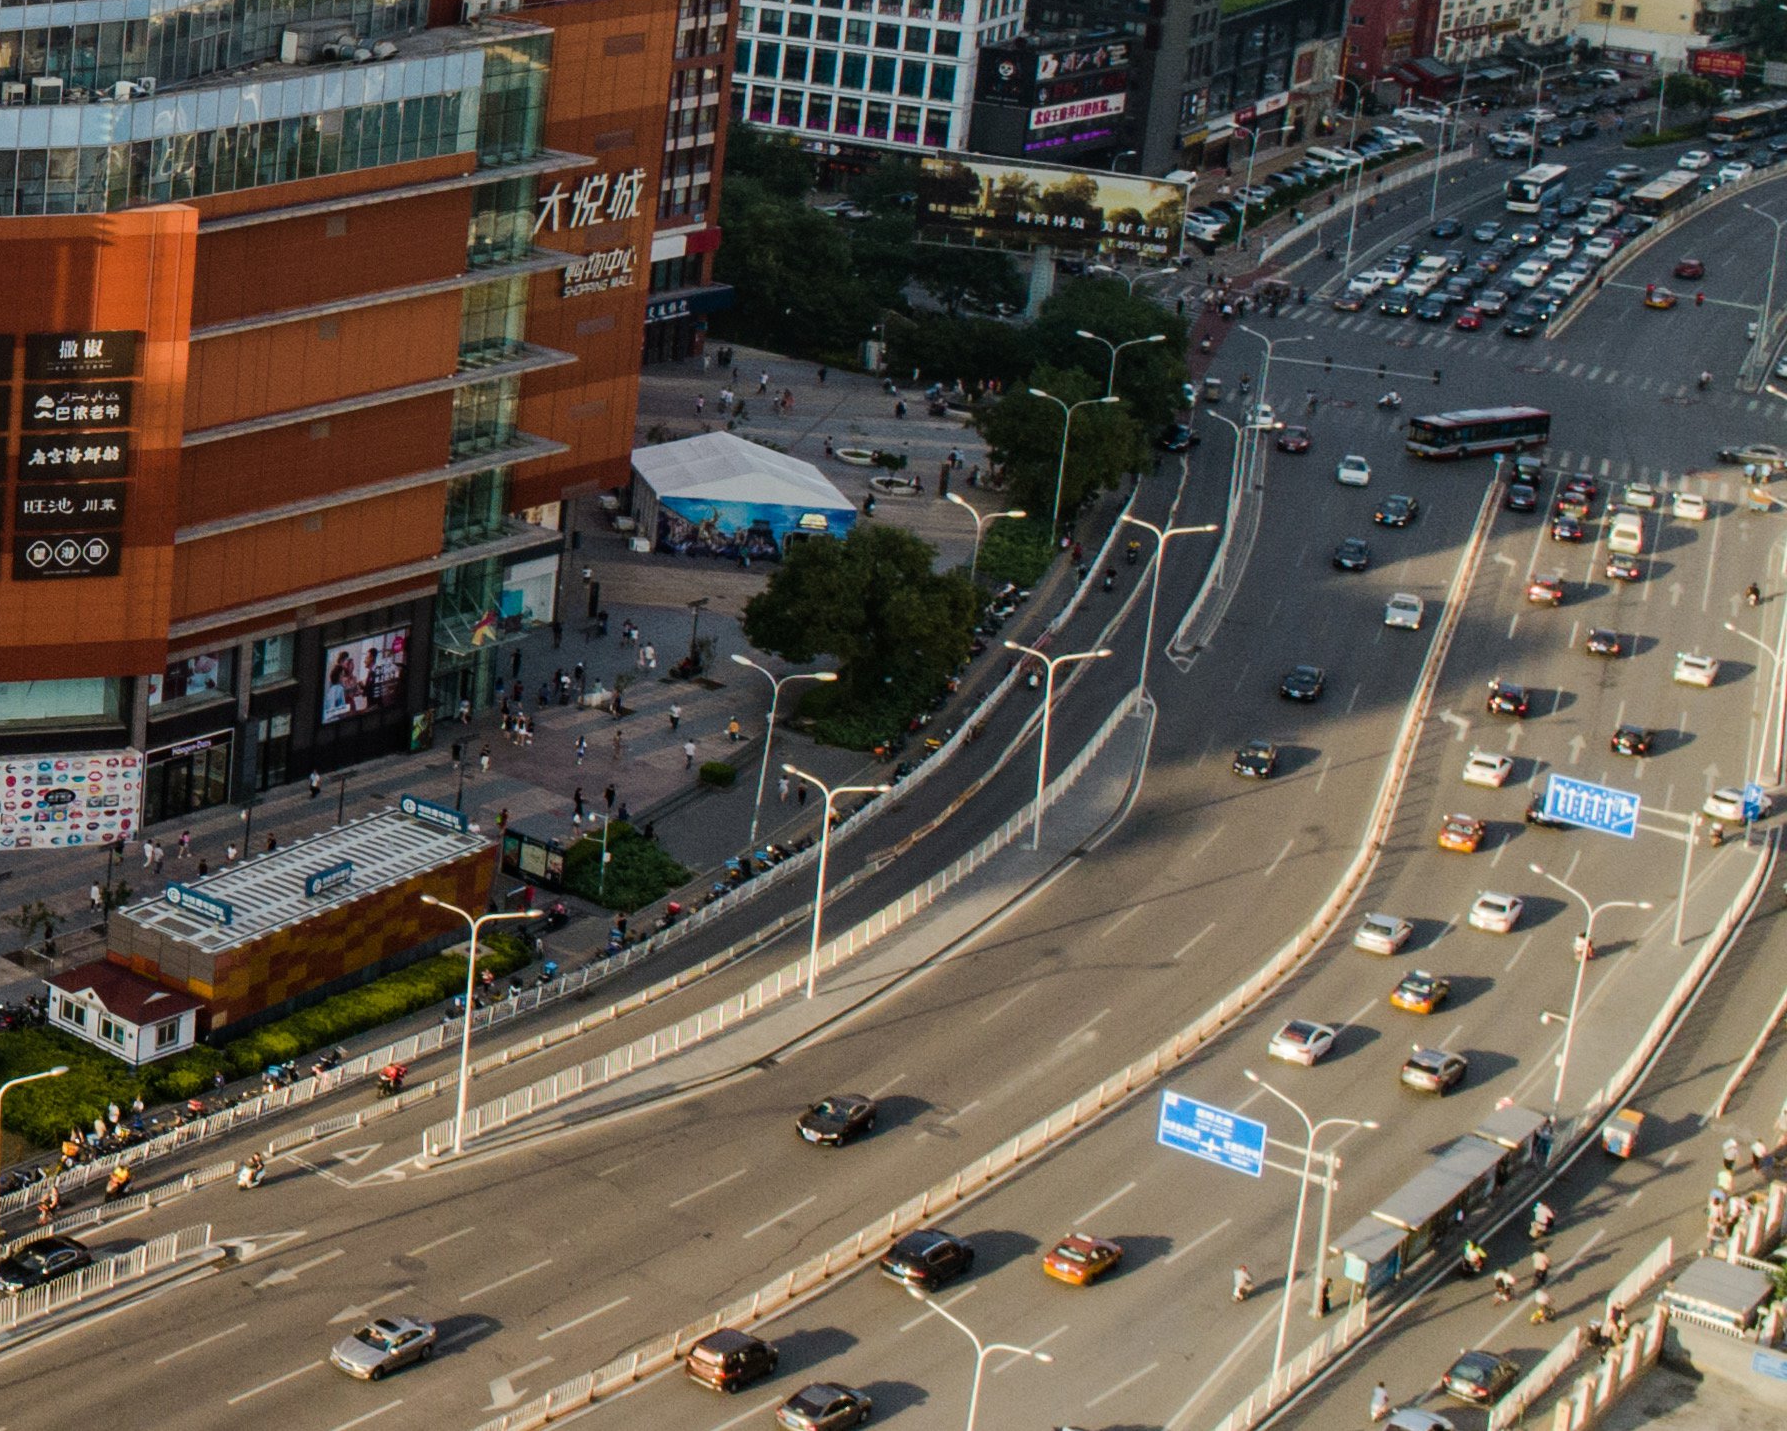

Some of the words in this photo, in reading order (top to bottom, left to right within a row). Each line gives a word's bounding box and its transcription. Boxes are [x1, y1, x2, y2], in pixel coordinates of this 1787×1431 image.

[532, 168, 646, 235] 大悦城
[564, 245, 637, 285] 购物中心
[55, 405, 120, 422] 巴依老爷
[24, 497, 75, 514] 旺池
[82, 499, 117, 512] 川菜
